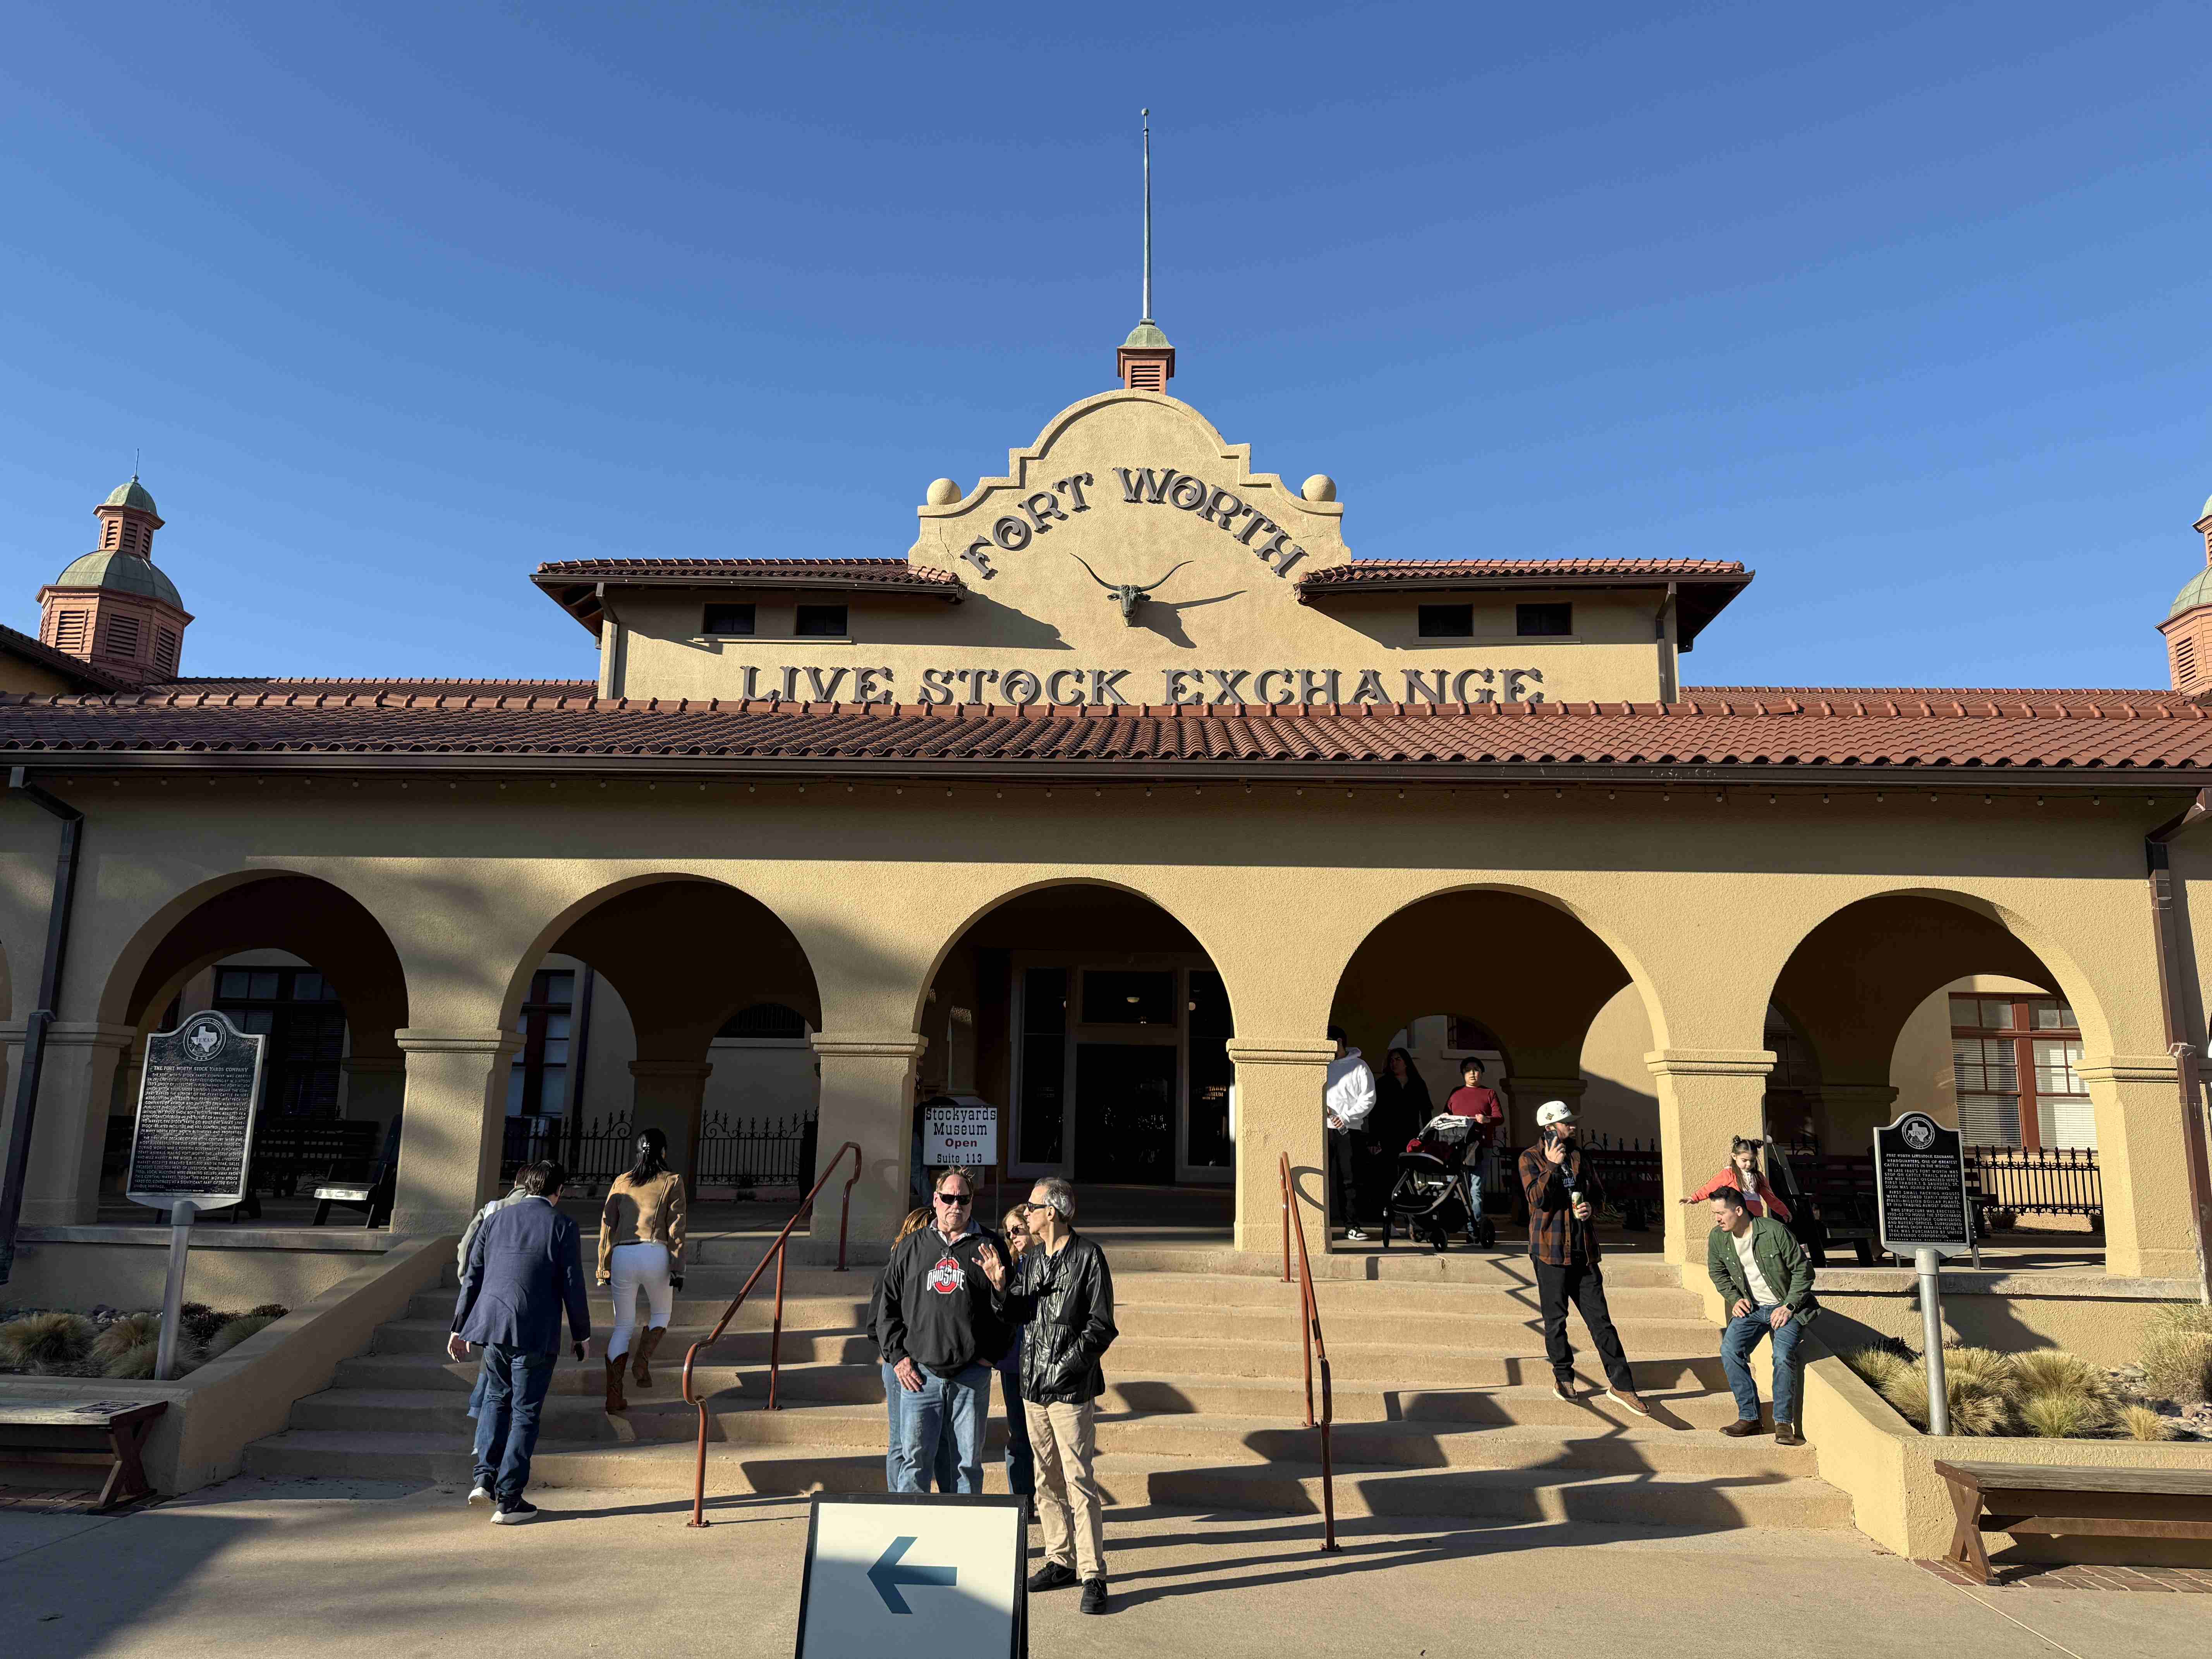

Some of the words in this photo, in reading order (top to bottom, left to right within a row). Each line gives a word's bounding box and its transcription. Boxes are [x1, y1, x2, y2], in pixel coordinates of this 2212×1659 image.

[960, 472, 1092, 579] FORT
[1113, 467, 1308, 578] WORTH
[740, 666, 893, 704] LIVE
[917, 668, 1132, 706] STOCK
[1162, 667, 1544, 704] EXCHANGE
[926, 1107, 996, 1123] Stockyards
[934, 1122, 987, 1135] Museum
[945, 1138, 977, 1149] Open
[937, 1153, 960, 1163] Suite
[966, 1153, 982, 1163] 113
[927, 1269, 944, 1291] OHIO
